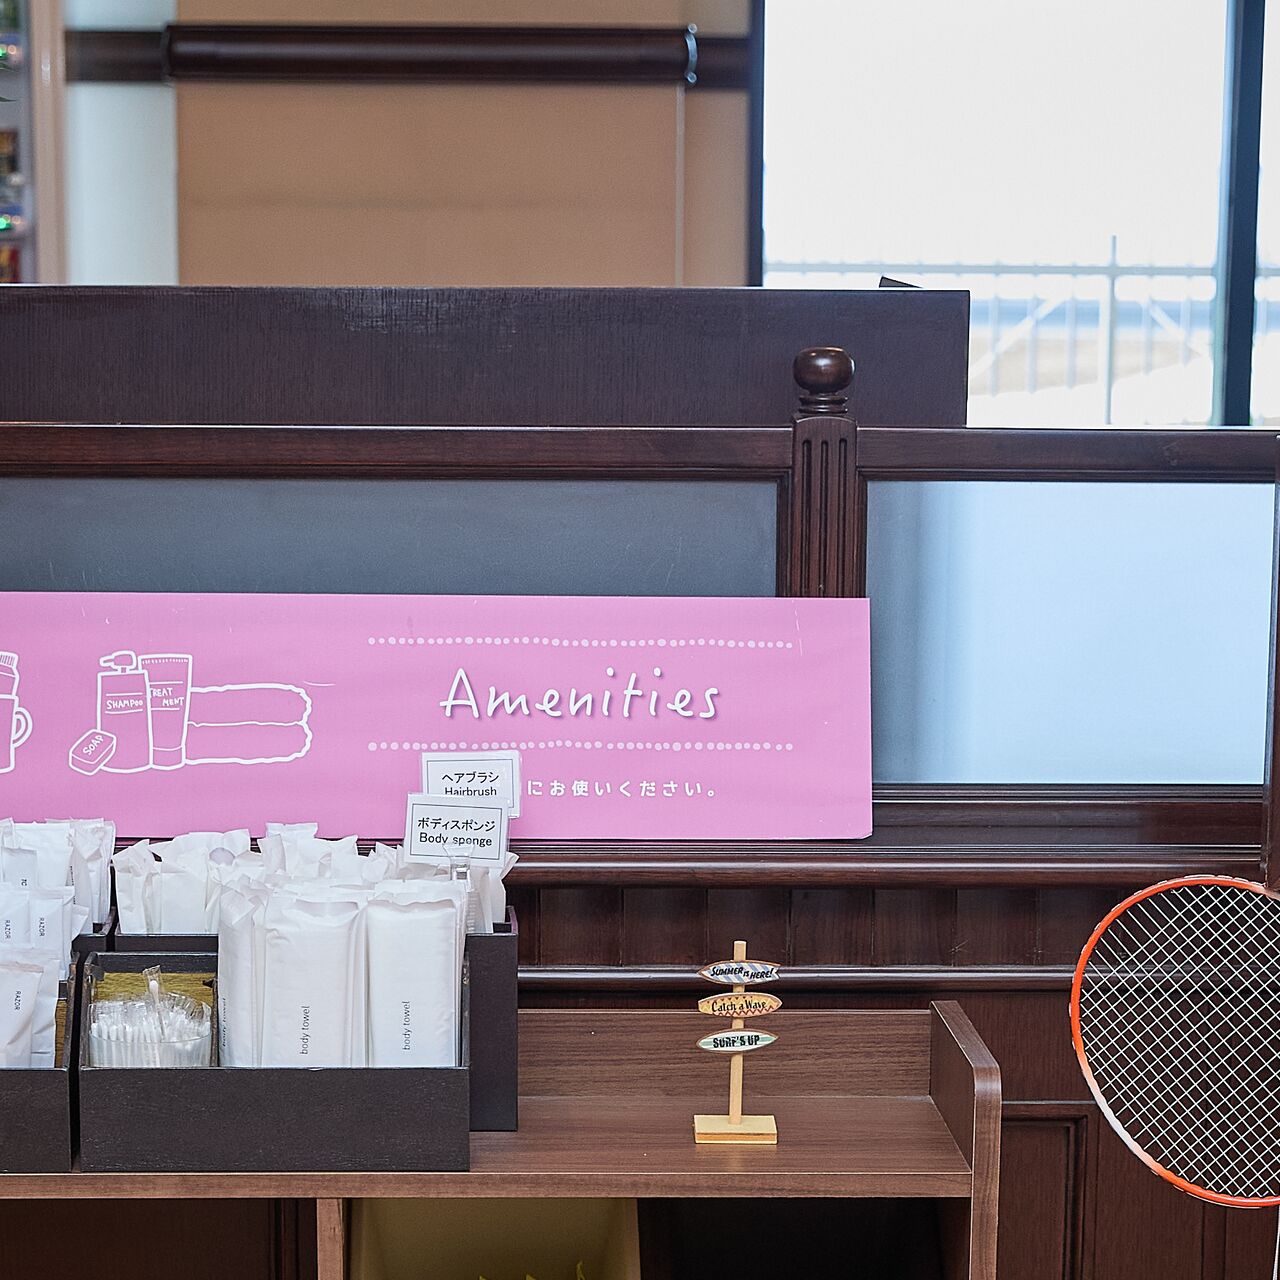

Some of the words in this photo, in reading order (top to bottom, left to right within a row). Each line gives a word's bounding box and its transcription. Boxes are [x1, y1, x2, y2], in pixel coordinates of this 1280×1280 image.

[439, 666, 719, 719] Amenities
[106, 698, 144, 711] SHAMPOO
[82, 734, 105, 756] SOAP
[442, 771, 500, 784] ヘアブラシ
[444, 786, 497, 796] Hairbrush
[417, 817, 496, 832] ボディスポンジ
[419, 832, 449, 845] Body
[452, 836, 493, 848] sponge
[710, 966, 743, 977] SUMMER
[749, 967, 775, 979] HERE!
[14, 990, 22, 1011] RAZOR
[711, 1000, 737, 1012] Catch
[744, 999, 767, 1009] Wave
[301, 1005, 310, 1031] towel
[402, 1001, 411, 1027] towel
[300, 1031, 311, 1055] body
[403, 1027, 413, 1051] body
[712, 1035, 746, 1048] SURF'S
[747, 1034, 760, 1046] UP
